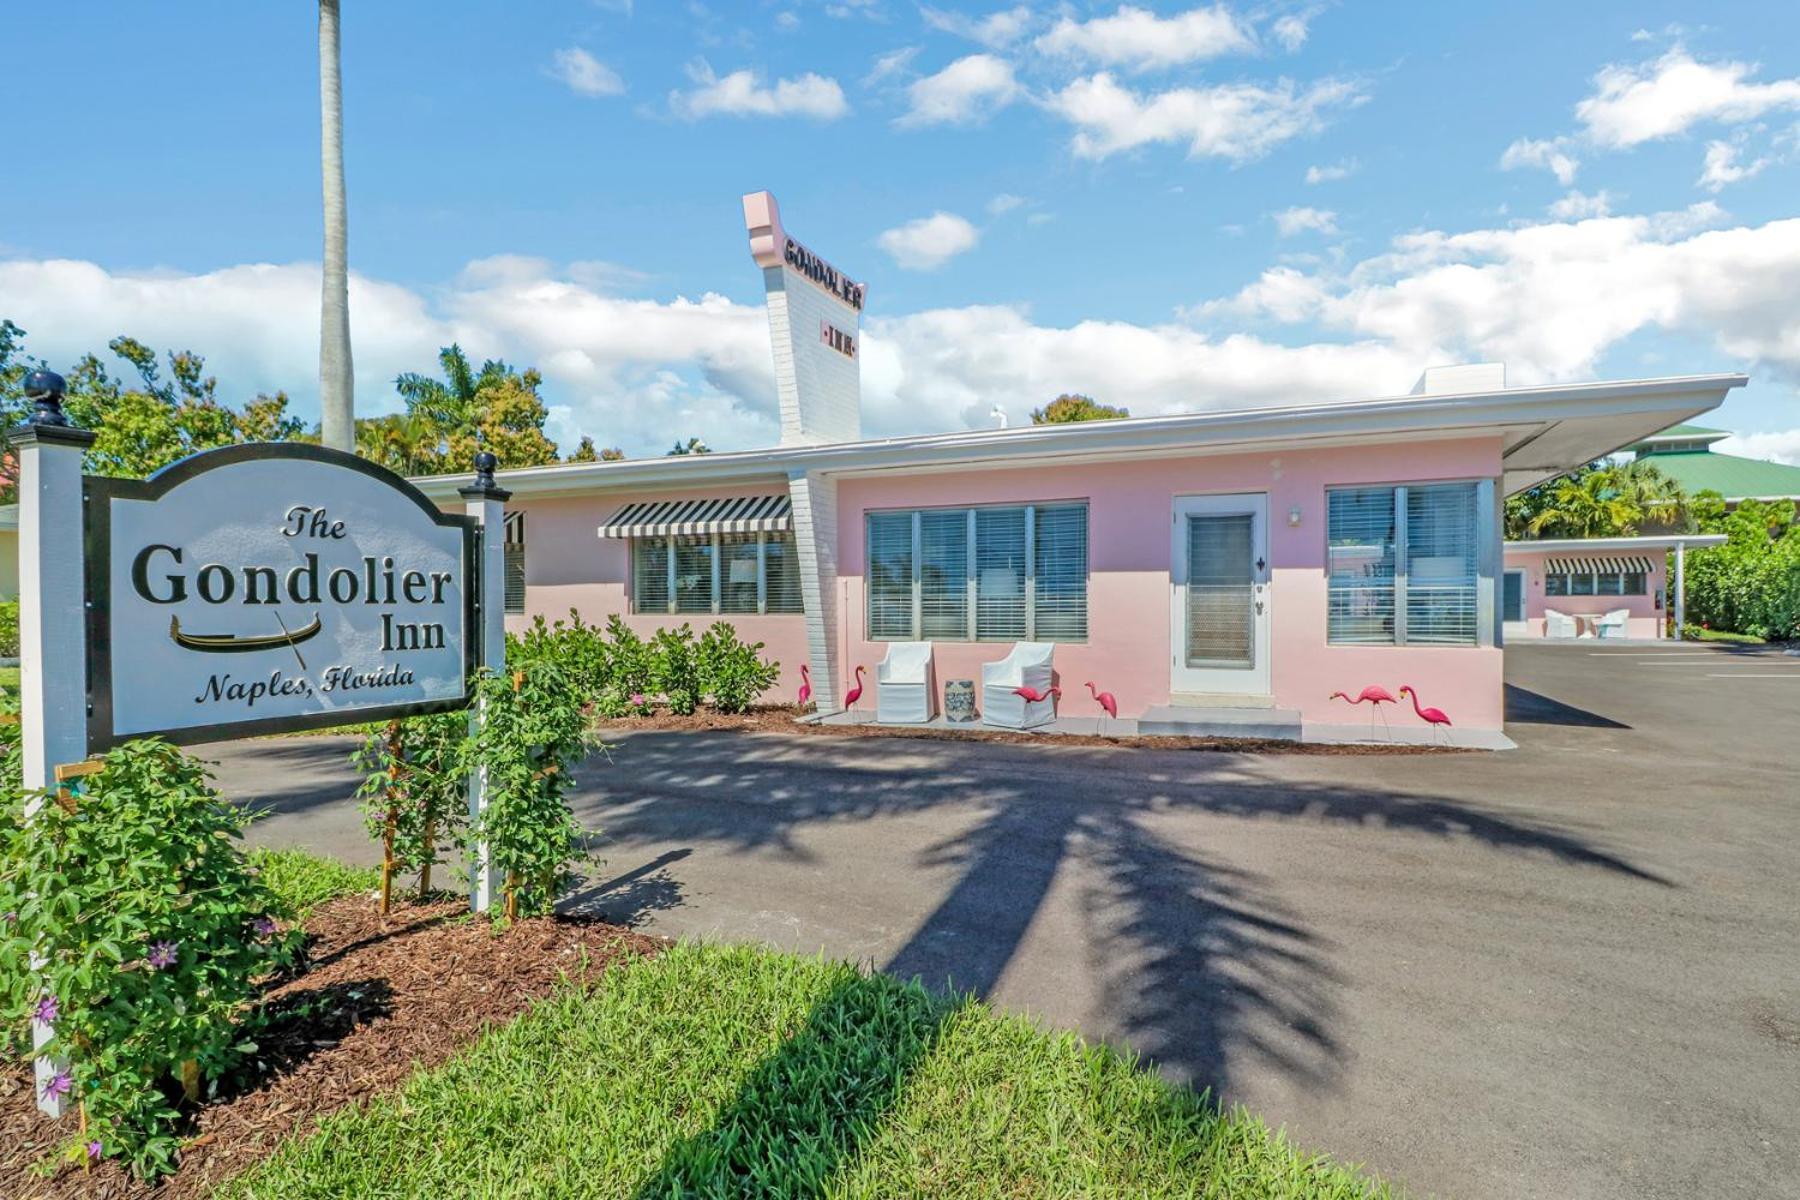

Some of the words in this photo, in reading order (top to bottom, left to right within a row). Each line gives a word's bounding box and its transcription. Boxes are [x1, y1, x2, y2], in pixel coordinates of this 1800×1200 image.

[281, 506, 346, 539] The
[131, 544, 452, 604] Gondolier
[380, 613, 446, 651] Inn
[195, 671, 313, 706] Naples,
[322, 663, 415, 692] Florida
